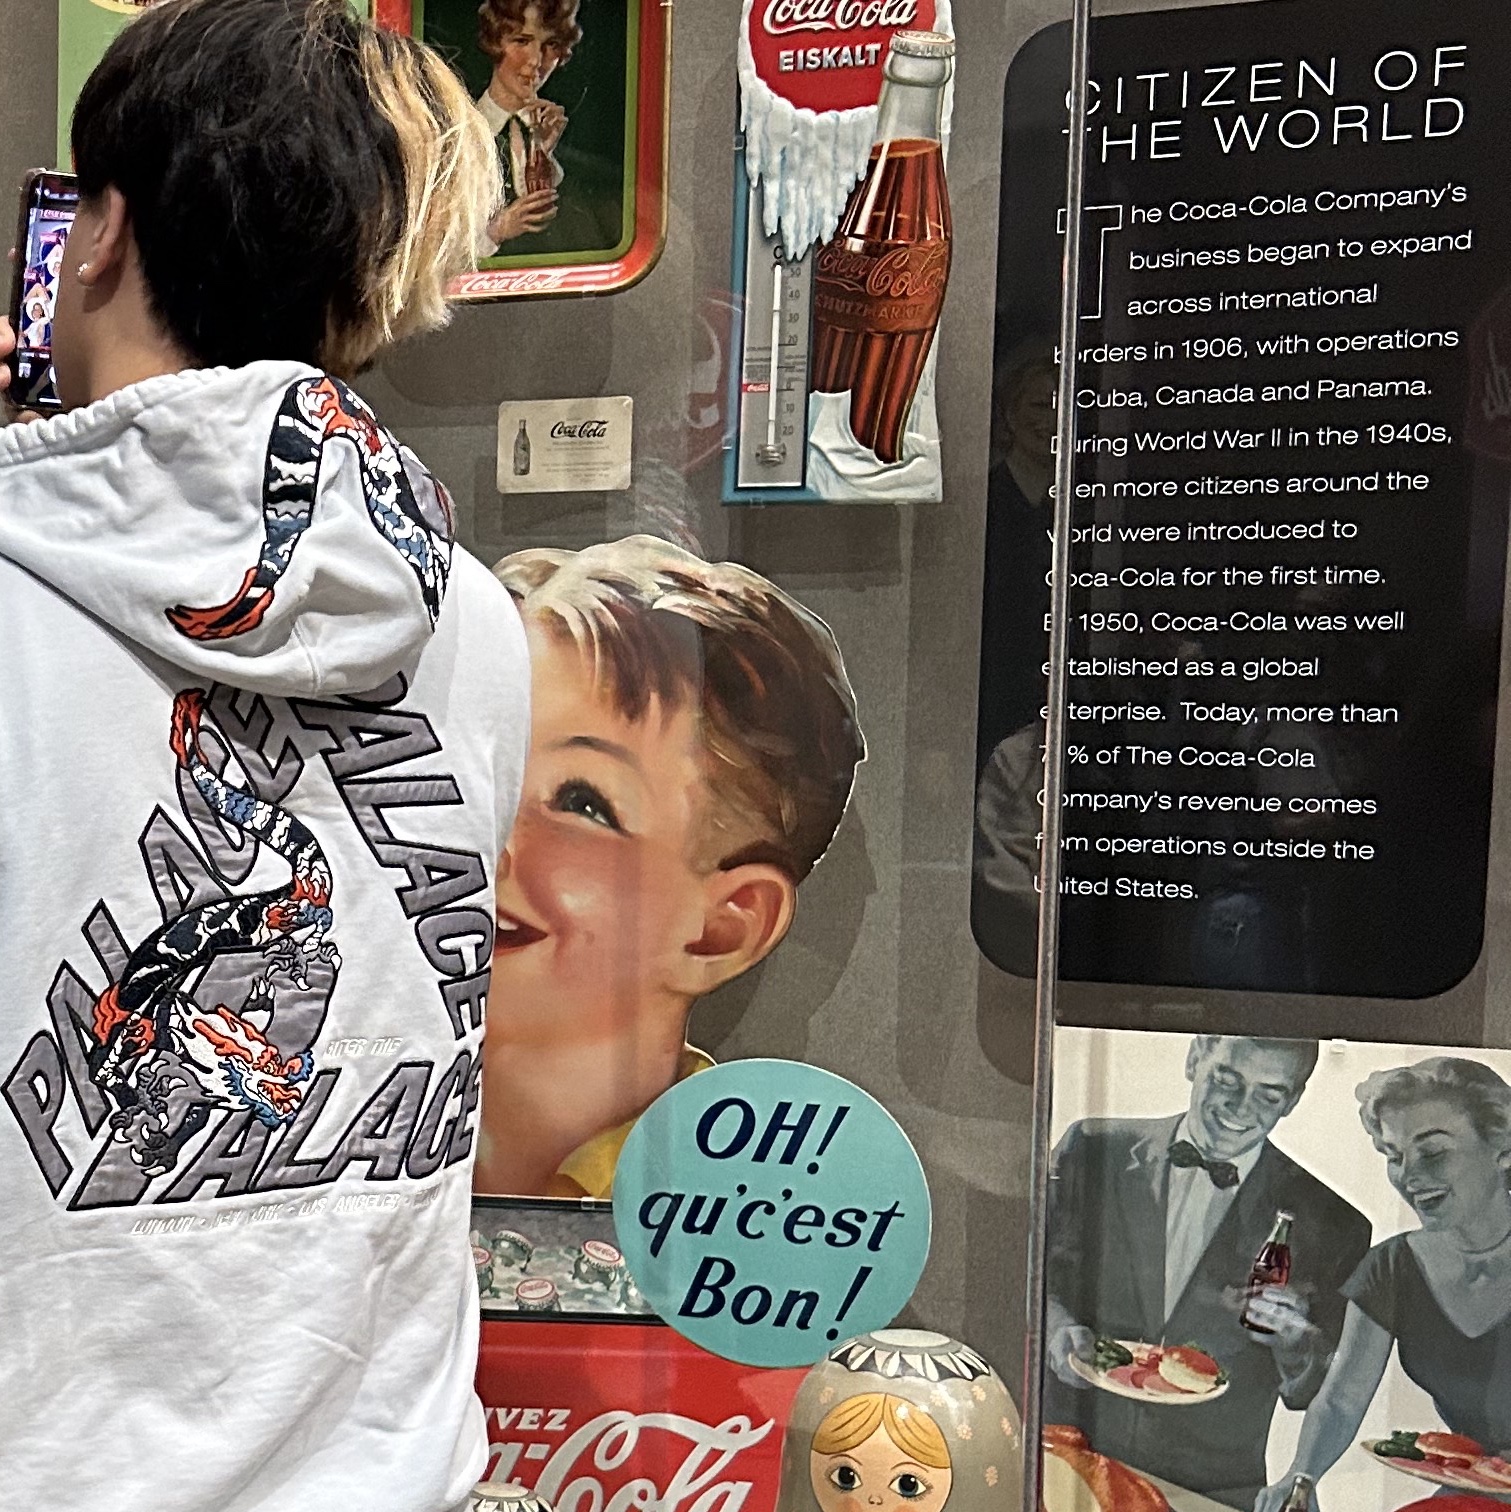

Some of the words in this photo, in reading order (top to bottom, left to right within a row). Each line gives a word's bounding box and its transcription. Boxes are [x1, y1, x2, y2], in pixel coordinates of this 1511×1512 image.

[779, 43, 882, 72] EISKALT
[1374, 46, 1466, 90] OF
[1214, 98, 1463, 153] WORLD
[1169, 195, 1307, 221] Coca-Cola
[1315, 183, 1466, 211] Company's
[1130, 249, 1240, 269] business
[1248, 244, 1329, 265] began
[1337, 239, 1363, 257] to
[1371, 230, 1472, 257] expand
[1128, 298, 1211, 315] across
[1220, 284, 1377, 310] international
[1155, 341, 1173, 359] in
[1182, 337, 1247, 358] 1906,
[1256, 335, 1308, 354] with
[1317, 330, 1458, 356] operations
[1077, 389, 1147, 408] Cuba,
[1156, 384, 1254, 405] Canada
[1262, 381, 1309, 401] and
[1318, 380, 1431, 398] Panama.
[1135, 431, 1206, 450] World
[1213, 430, 1264, 448] War
[1272, 429, 1280, 446] II
[1289, 428, 1308, 446] in
[1316, 427, 1358, 445] the
[1367, 423, 1451, 443] 1940s,
[1049, 484, 1105, 497] een
[1114, 482, 1177, 496] more
[1185, 476, 1279, 495] citizens
[1287, 472, 1378, 492] around
[1386, 471, 1429, 490] the
[1118, 527, 1180, 541] were
[1188, 520, 1324, 540] introduced
[1332, 520, 1357, 538] to
[1182, 568, 1216, 586] for
[1223, 567, 1263, 585] the
[1270, 566, 1317, 584] first
[1324, 566, 1385, 584] time.
[1079, 613, 1143, 633] 1950,
[1152, 612, 1287, 631] Coca-Cola
[1294, 616, 1346, 630] was
[1354, 612, 1404, 630] well
[1042, 658, 1177, 676] etablished
[1185, 662, 1213, 676] as
[1221, 662, 1236, 676] a
[1243, 658, 1318, 680] global
[1040, 702, 1165, 723] eterprise.
[1180, 702, 1258, 725] Today,
[1267, 707, 1333, 722] more
[1341, 704, 1397, 722] than
[1096, 746, 1121, 764] of
[1126, 746, 1172, 765] The
[1179, 747, 1315, 767] Coca-Cola
[1179, 796, 1281, 811] revenue
[1289, 798, 1376, 814] comes
[1096, 836, 1226, 855] operations
[1233, 839, 1326, 858] outside
[1333, 841, 1374, 859] the
[1116, 878, 1198, 898] States.
[695, 1096, 852, 1175] OH!
[484, 1407, 571, 1431] VEZ
